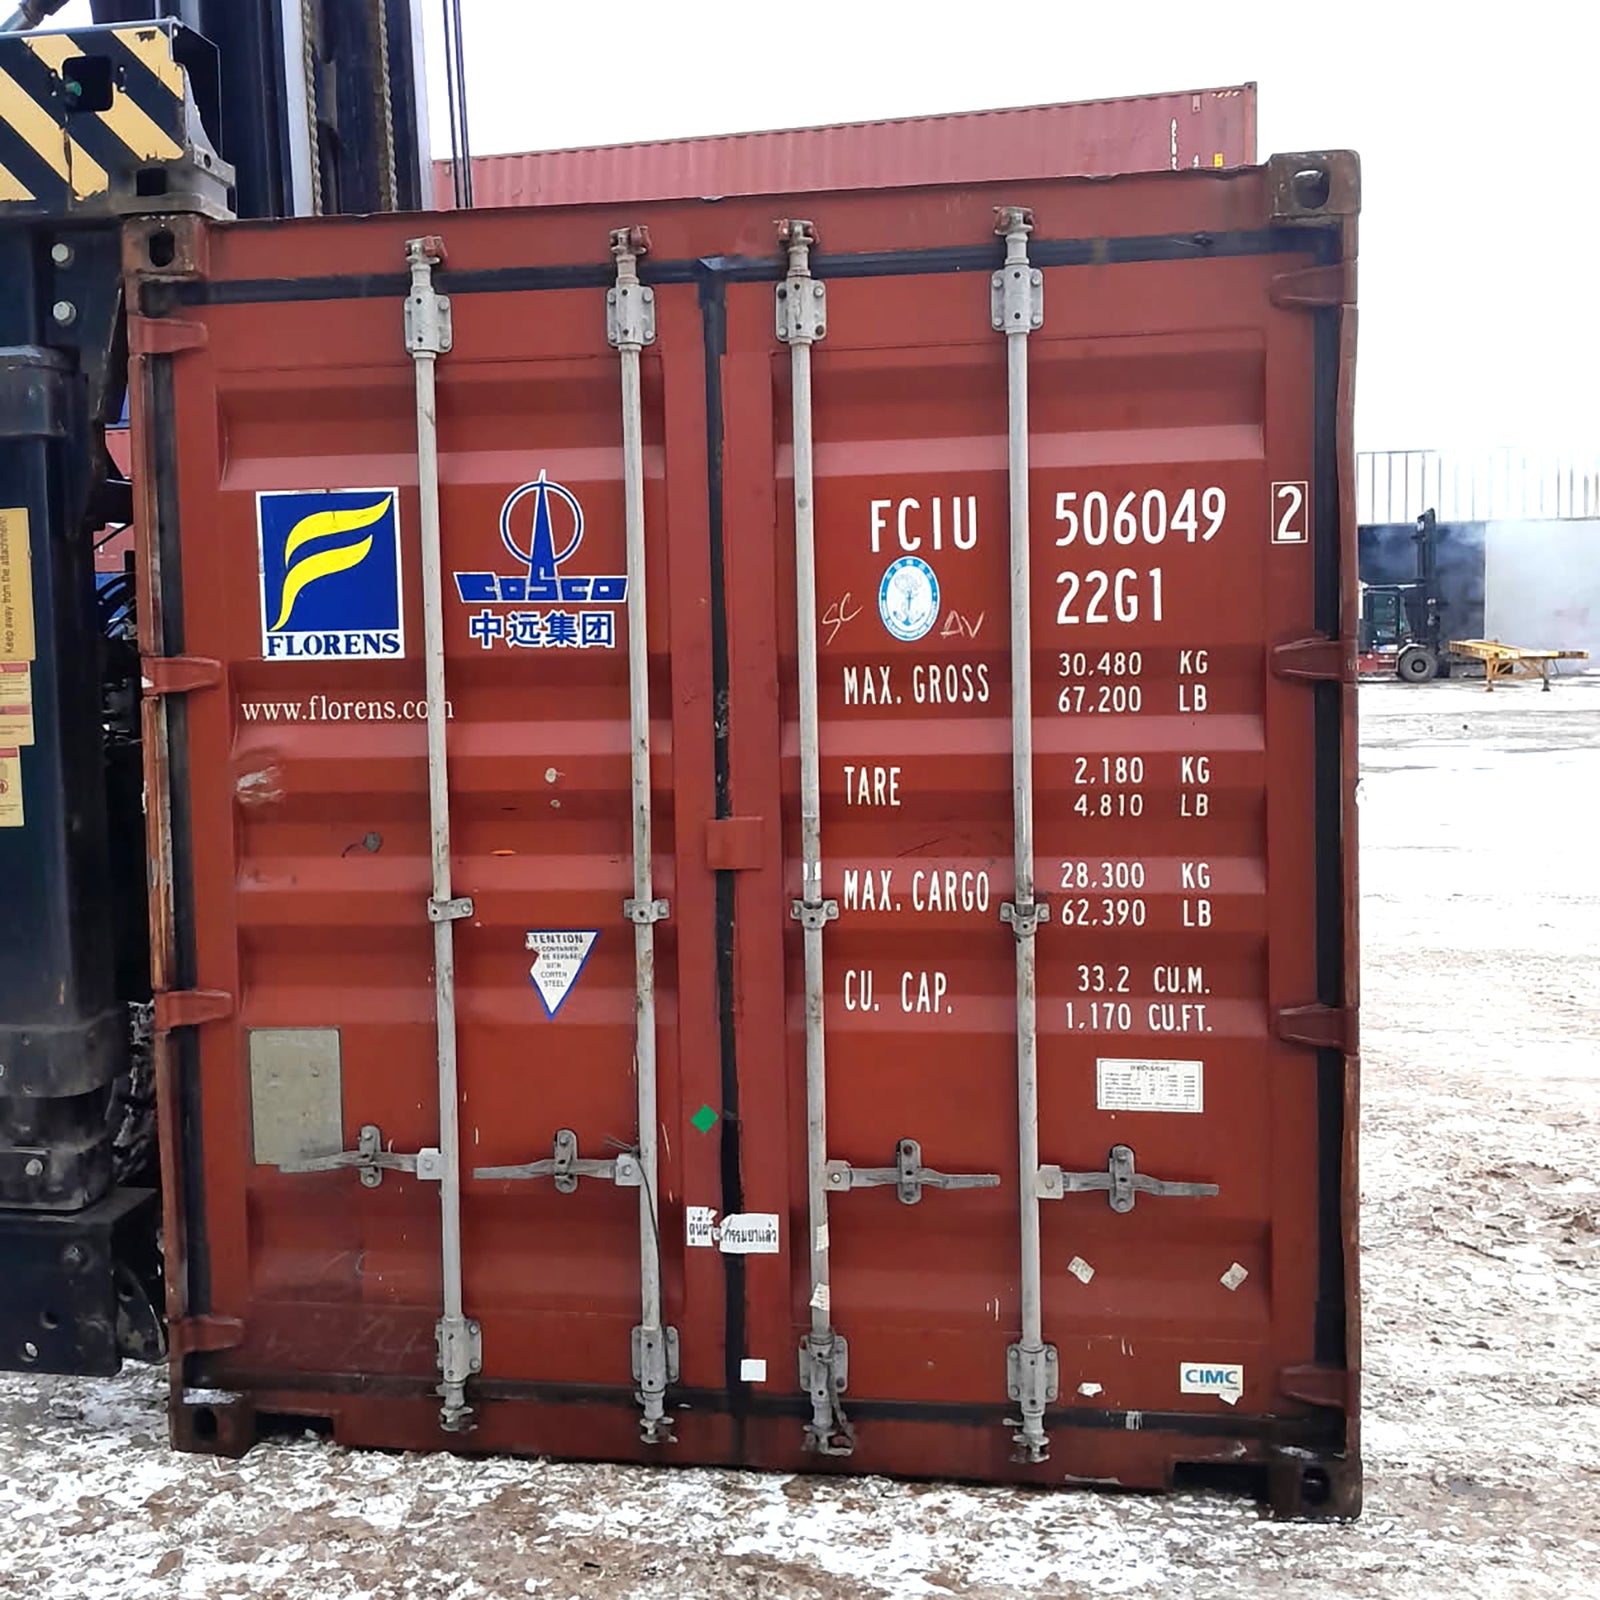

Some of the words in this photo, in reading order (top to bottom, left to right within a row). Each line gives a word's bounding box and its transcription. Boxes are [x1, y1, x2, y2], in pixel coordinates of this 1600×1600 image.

[870, 496, 977, 552] FCIU
[1055, 486, 1226, 546] 506049
[1276, 485, 1302, 540] 2
[453, 570, 628, 603] COSCO
[1056, 568, 1162, 624] 22G1
[266, 633, 400, 656] FLORENS
[469, 608, 615, 649] 中远集团
[843, 666, 902, 705] MAX.
[912, 664, 990, 703] GROSS
[1179, 650, 1209, 675] KG
[1179, 684, 1208, 712] LB
[844, 766, 902, 806] TARE
[1181, 756, 1211, 784] KG
[1180, 793, 1209, 817] LB
[844, 870, 902, 912] MAX.
[912, 870, 990, 912] CARGO
[1182, 862, 1212, 889] KG
[1183, 900, 1212, 927] LB
[844, 970, 881, 1012] CU.
[901, 972, 953, 1014] CAP.
[1077, 965, 1131, 993] 33.2
[1185, 1368, 1238, 1385] CIMC
